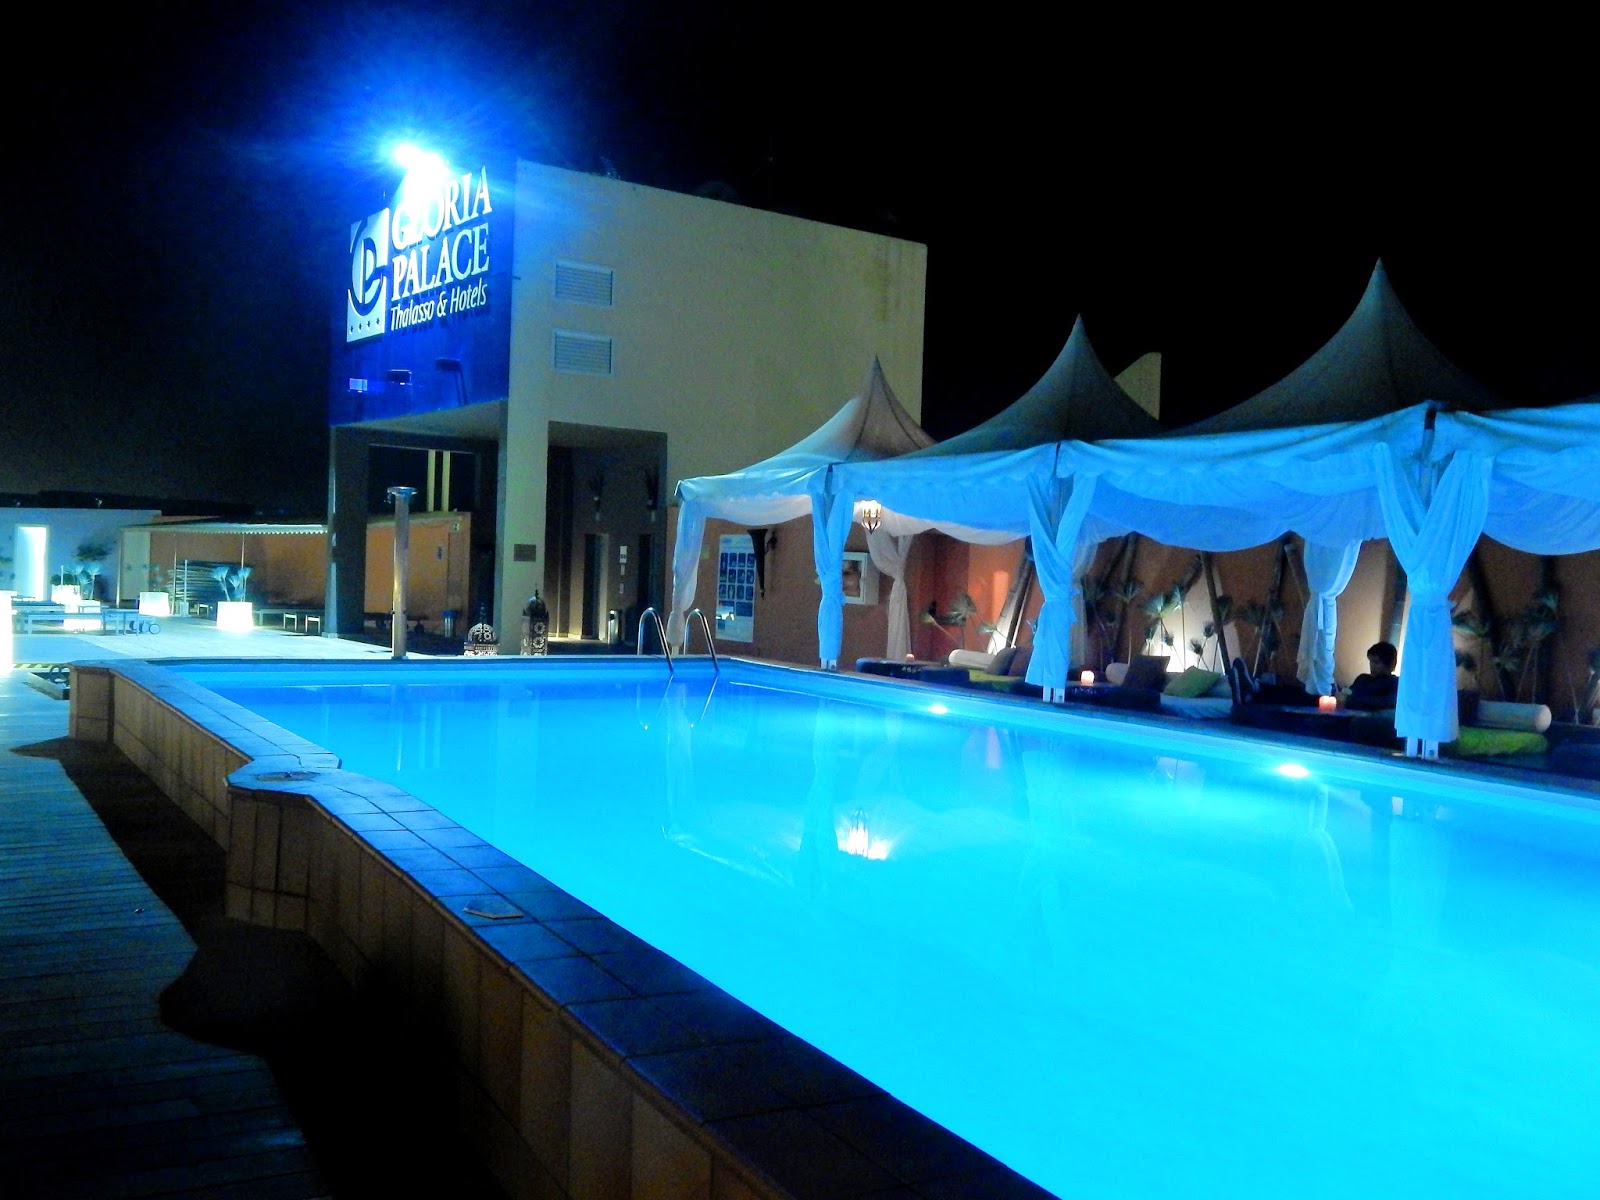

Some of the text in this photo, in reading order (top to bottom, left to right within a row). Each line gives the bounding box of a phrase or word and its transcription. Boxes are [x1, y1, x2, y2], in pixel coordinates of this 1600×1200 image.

[391, 223, 489, 301] PALACE
[391, 278, 488, 331] Thalasso & Hotels
